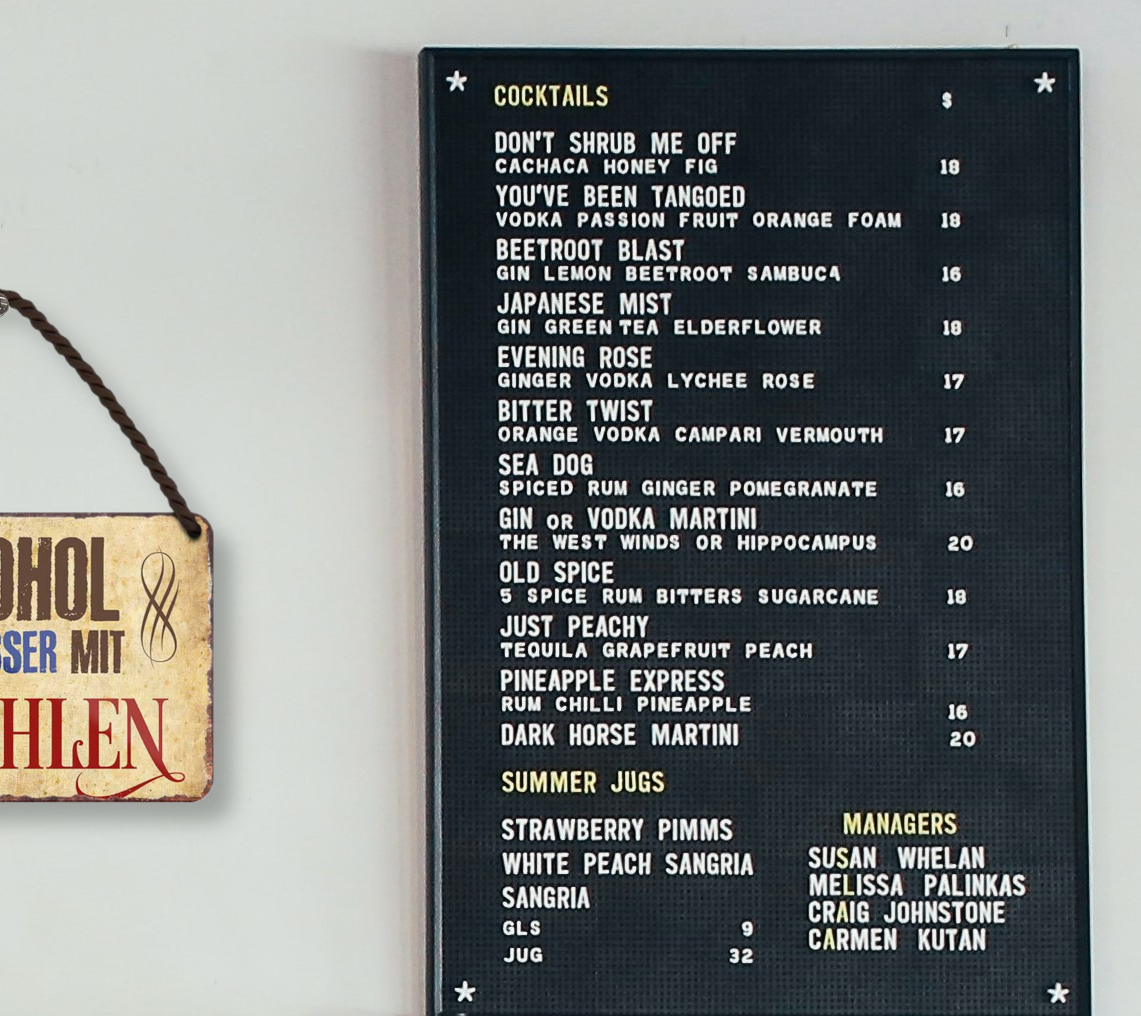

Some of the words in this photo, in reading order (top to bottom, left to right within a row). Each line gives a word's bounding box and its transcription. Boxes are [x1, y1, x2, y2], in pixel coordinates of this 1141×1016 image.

[494, 84, 609, 107] COCKTAILS
[941, 91, 953, 109] $
[494, 130, 555, 154] DON'T
[569, 131, 636, 155] SHRUB
[650, 131, 684, 155] ME
[697, 131, 737, 155] OFF
[495, 157, 589, 175] CACHACA
[603, 158, 671, 175] HONEY
[685, 158, 718, 175] FIG
[940, 158, 960, 175] 18
[495, 183, 569, 208] YOU'VE
[583, 184, 637, 208] BEEN
[650, 184, 746, 209] TANGOED
[495, 211, 563, 228] VODKA
[577, 211, 665, 228] PASSION
[679, 211, 739, 229] FRUIT
[752, 211, 833, 229] ORANGE
[848, 211, 902, 229] FOAM
[941, 212, 961, 229] 18
[496, 238, 604, 262] BEETROOT
[618, 238, 685, 262] BLAST
[496, 265, 530, 282] GIN
[544, 265, 612, 282] LEMON
[625, 265, 733, 282] BEETROOT
[747, 265, 841, 282] SAMBUCA
[941, 266, 962, 283] 16
[496, 291, 605, 315] JAPANESE
[619, 292, 672, 316] MIST
[497, 318, 531, 335] GIN
[544, 318, 613, 335] GREEN
[618, 319, 659, 336] TEA
[673, 318, 822, 336] ELDERFLOWER
[942, 319, 962, 336] 18
[497, 345, 585, 369] EVENING
[599, 345, 653, 370] ROSE
[497, 372, 572, 389] GINGER
[585, 372, 653, 389] VODKA
[667, 372, 748, 389] LYCHEE
[762, 372, 815, 390] ROSE
[943, 373, 965, 390] 17
[498, 399, 573, 423] BITTER
[585, 399, 653, 423] TWIST
[497, 425, 579, 443] ORANGE
[593, 426, 661, 443] VODKA
[674, 426, 762, 443] CAMPARI
[776, 426, 884, 444] VERMOUTH
[944, 427, 966, 444] 17
[498, 453, 539, 476] SEA
[552, 453, 594, 476] DOG
[499, 479, 574, 497] SPICED
[587, 479, 628, 497] RUM
[641, 479, 716, 497] GINGER
[729, 480, 878, 498] POMEGRANATE
[945, 481, 965, 498] 16
[499, 506, 533, 530] GIN
[546, 513, 574, 531] OR
[587, 506, 656, 530] VODKA
[669, 506, 757, 531] MARTINI
[499, 533, 539, 550] THE
[552, 533, 608, 551] WEST
[619, 533, 680, 551] WINDS
[695, 534, 723, 551] OR
[737, 534, 877, 552] HIPPOCAMPUS
[947, 535, 974, 552] 20
[499, 560, 540, 584] OLD
[553, 560, 615, 584] SPICE
[499, 587, 512, 604] 5
[527, 587, 587, 605] SPICE
[602, 587, 643, 605] RUM
[656, 587, 743, 605] BITTERS
[758, 588, 879, 606] SUGARCANE
[946, 588, 967, 605] 18
[499, 614, 554, 638] JUST
[567, 614, 649, 638] PEACHY
[70, 629, 125, 674] MIT
[500, 641, 588, 659] TEQUILA
[602, 641, 731, 659] GRAPEFRUIT
[745, 642, 813, 659] PEACH
[947, 643, 969, 660] 17
[500, 668, 616, 692] PINEAPPLE
[630, 669, 725, 693] EXPRESS
[501, 695, 542, 712] RUM
[555, 696, 623, 713] CHILLI
[637, 695, 752, 713] PINEAPPLE
[947, 703, 968, 721] 16
[501, 723, 556, 746] DARK
[569, 722, 637, 747] HORSE
[651, 722, 739, 747] MARTINI
[949, 730, 977, 748] 20
[501, 770, 597, 794] SUMMER
[610, 770, 665, 793] JUGS
[501, 817, 644, 842] STRAWBERRY
[658, 818, 734, 842] PIMMS
[843, 812, 958, 836] MANAGERS
[502, 851, 570, 876] WHITE
[583, 851, 652, 876] PEACH
[665, 852, 754, 876] SANGRIA
[808, 846, 877, 870] SUSAN
[897, 846, 985, 870] WHELAN
[809, 873, 904, 897] MELISSA
[924, 873, 1027, 897] PALINKAS
[502, 885, 591, 910] SANGRIA
[808, 900, 870, 924] CRAIG
[883, 900, 1006, 924] JOHNSTONE
[502, 920, 541, 936] GLS
[741, 920, 754, 937] 9
[808, 927, 898, 951] CARMEN
[917, 927, 987, 952] KUTAN
[503, 947, 543, 963] JUG
[729, 947, 754, 964] 32
